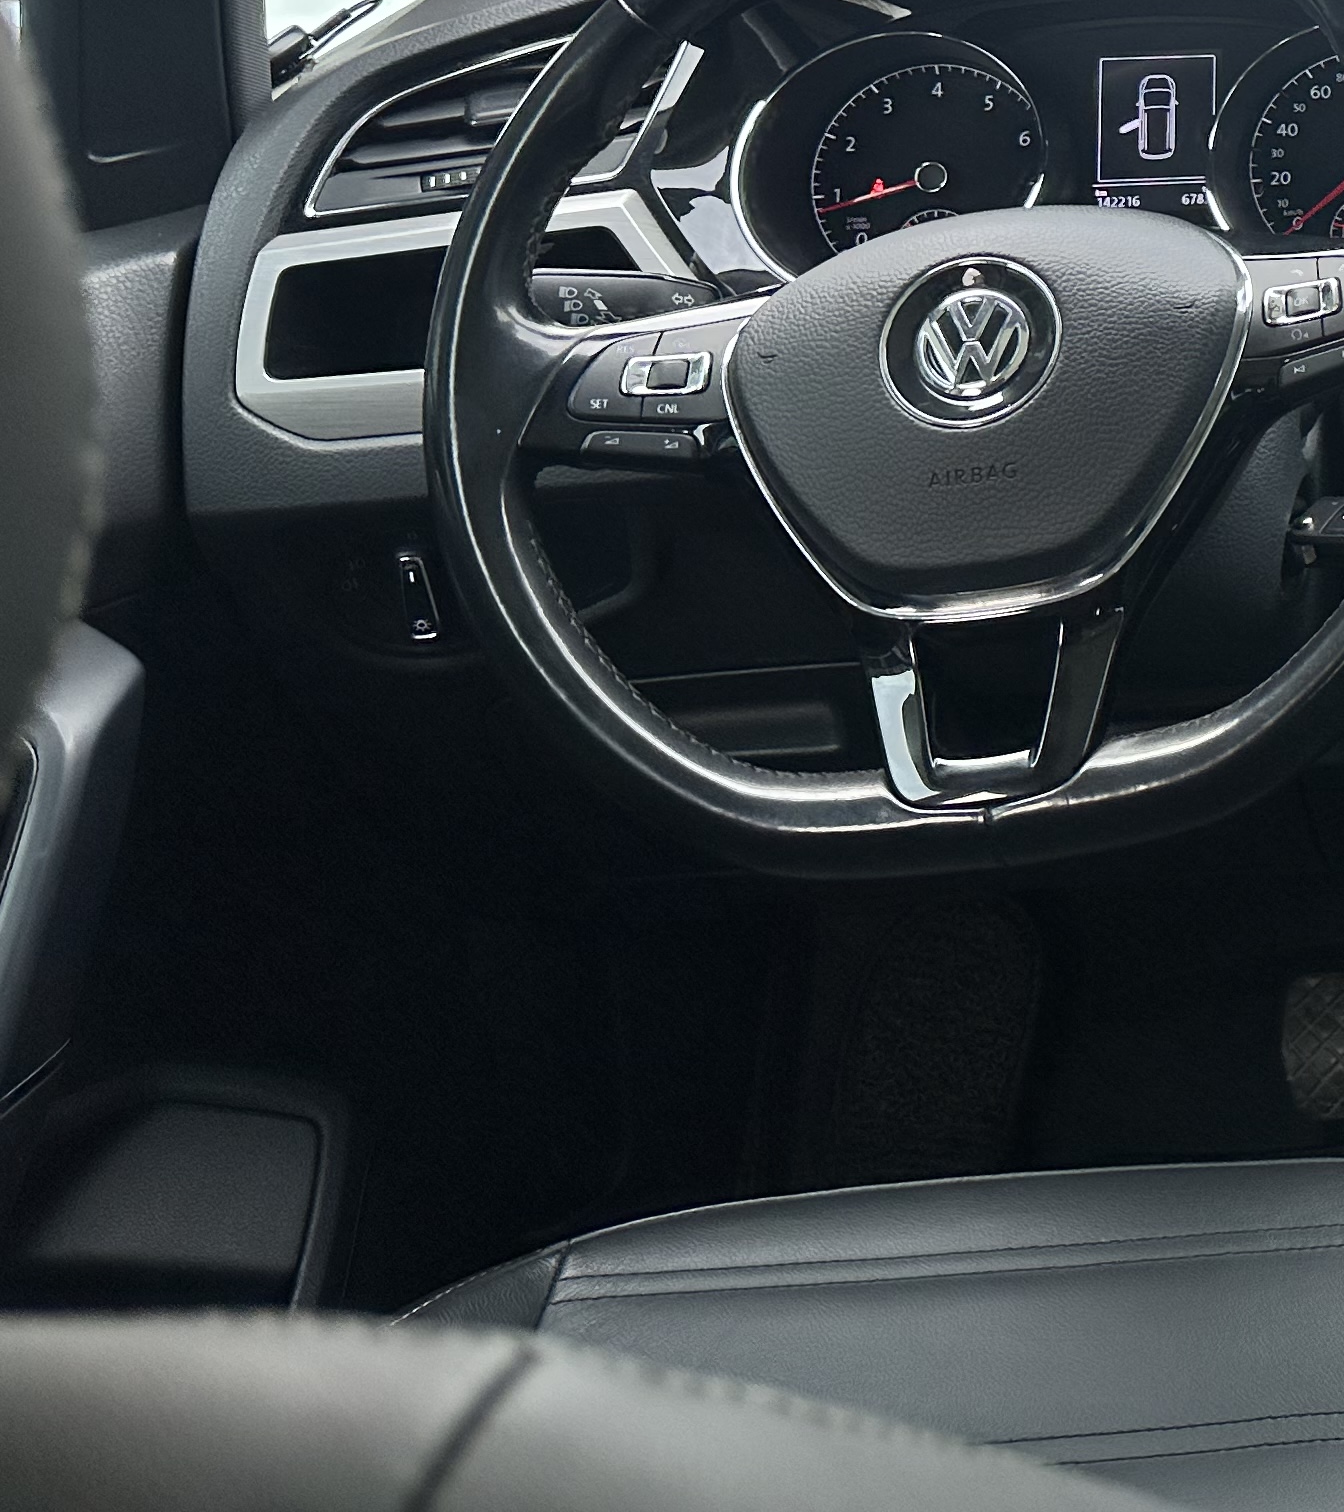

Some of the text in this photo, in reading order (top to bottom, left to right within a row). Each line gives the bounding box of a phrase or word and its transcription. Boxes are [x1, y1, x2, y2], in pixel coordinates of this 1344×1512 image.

[930, 82, 943, 97] 4
[1310, 86, 1331, 99] 60
[883, 99, 893, 114] 3
[983, 96, 994, 111] 5
[1292, 103, 1306, 113] 50
[1276, 123, 1298, 136] 40
[845, 137, 856, 151] 2
[1019, 131, 1031, 146] 6
[1270, 148, 1285, 158] 30
[1270, 172, 1291, 185] 20
[833, 188, 841, 203] 1
[1097, 196, 1141, 208] 142216
[589, 398, 609, 410] SET
[656, 403, 680, 415] CNL
[928, 462, 1018, 488] AIRBAG
